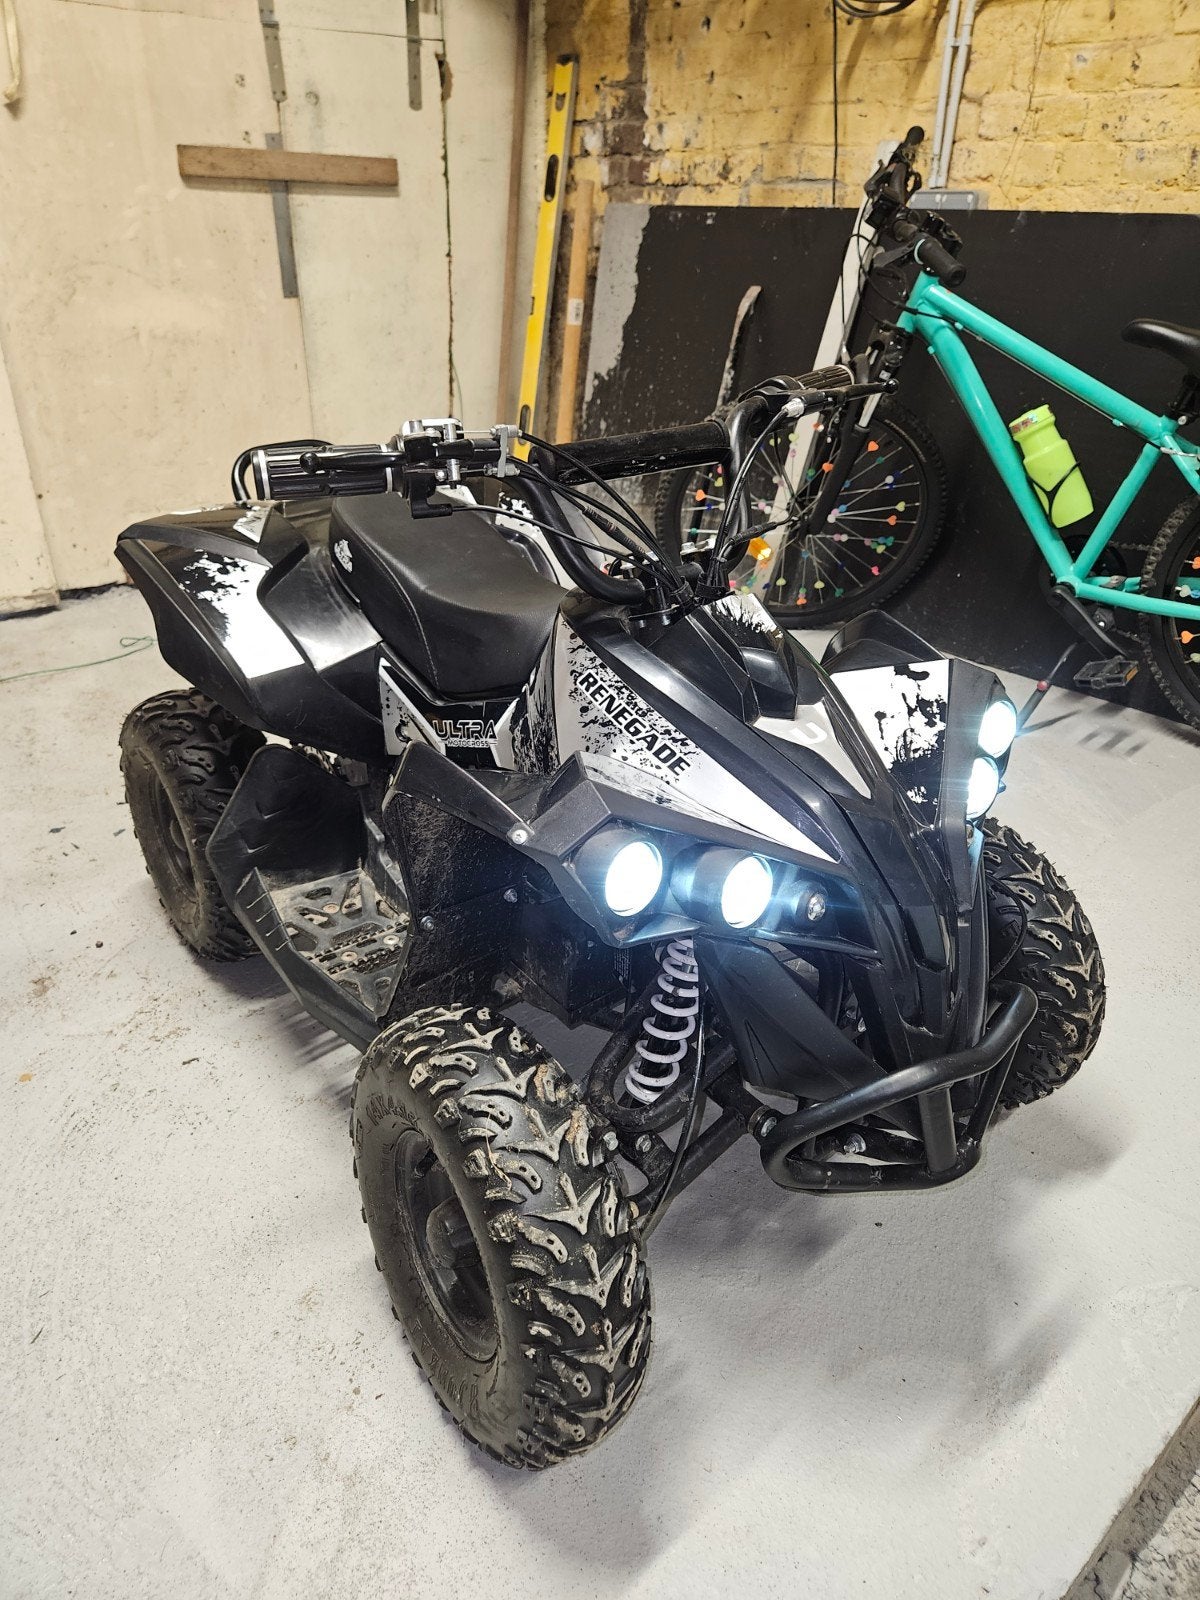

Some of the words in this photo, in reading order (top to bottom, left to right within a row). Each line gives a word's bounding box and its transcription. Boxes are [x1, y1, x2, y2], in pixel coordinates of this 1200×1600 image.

[433, 719, 498, 741] ULTRA
[578, 671, 691, 776] RENEGADE
[447, 738, 491, 748] MOTOCROSS
